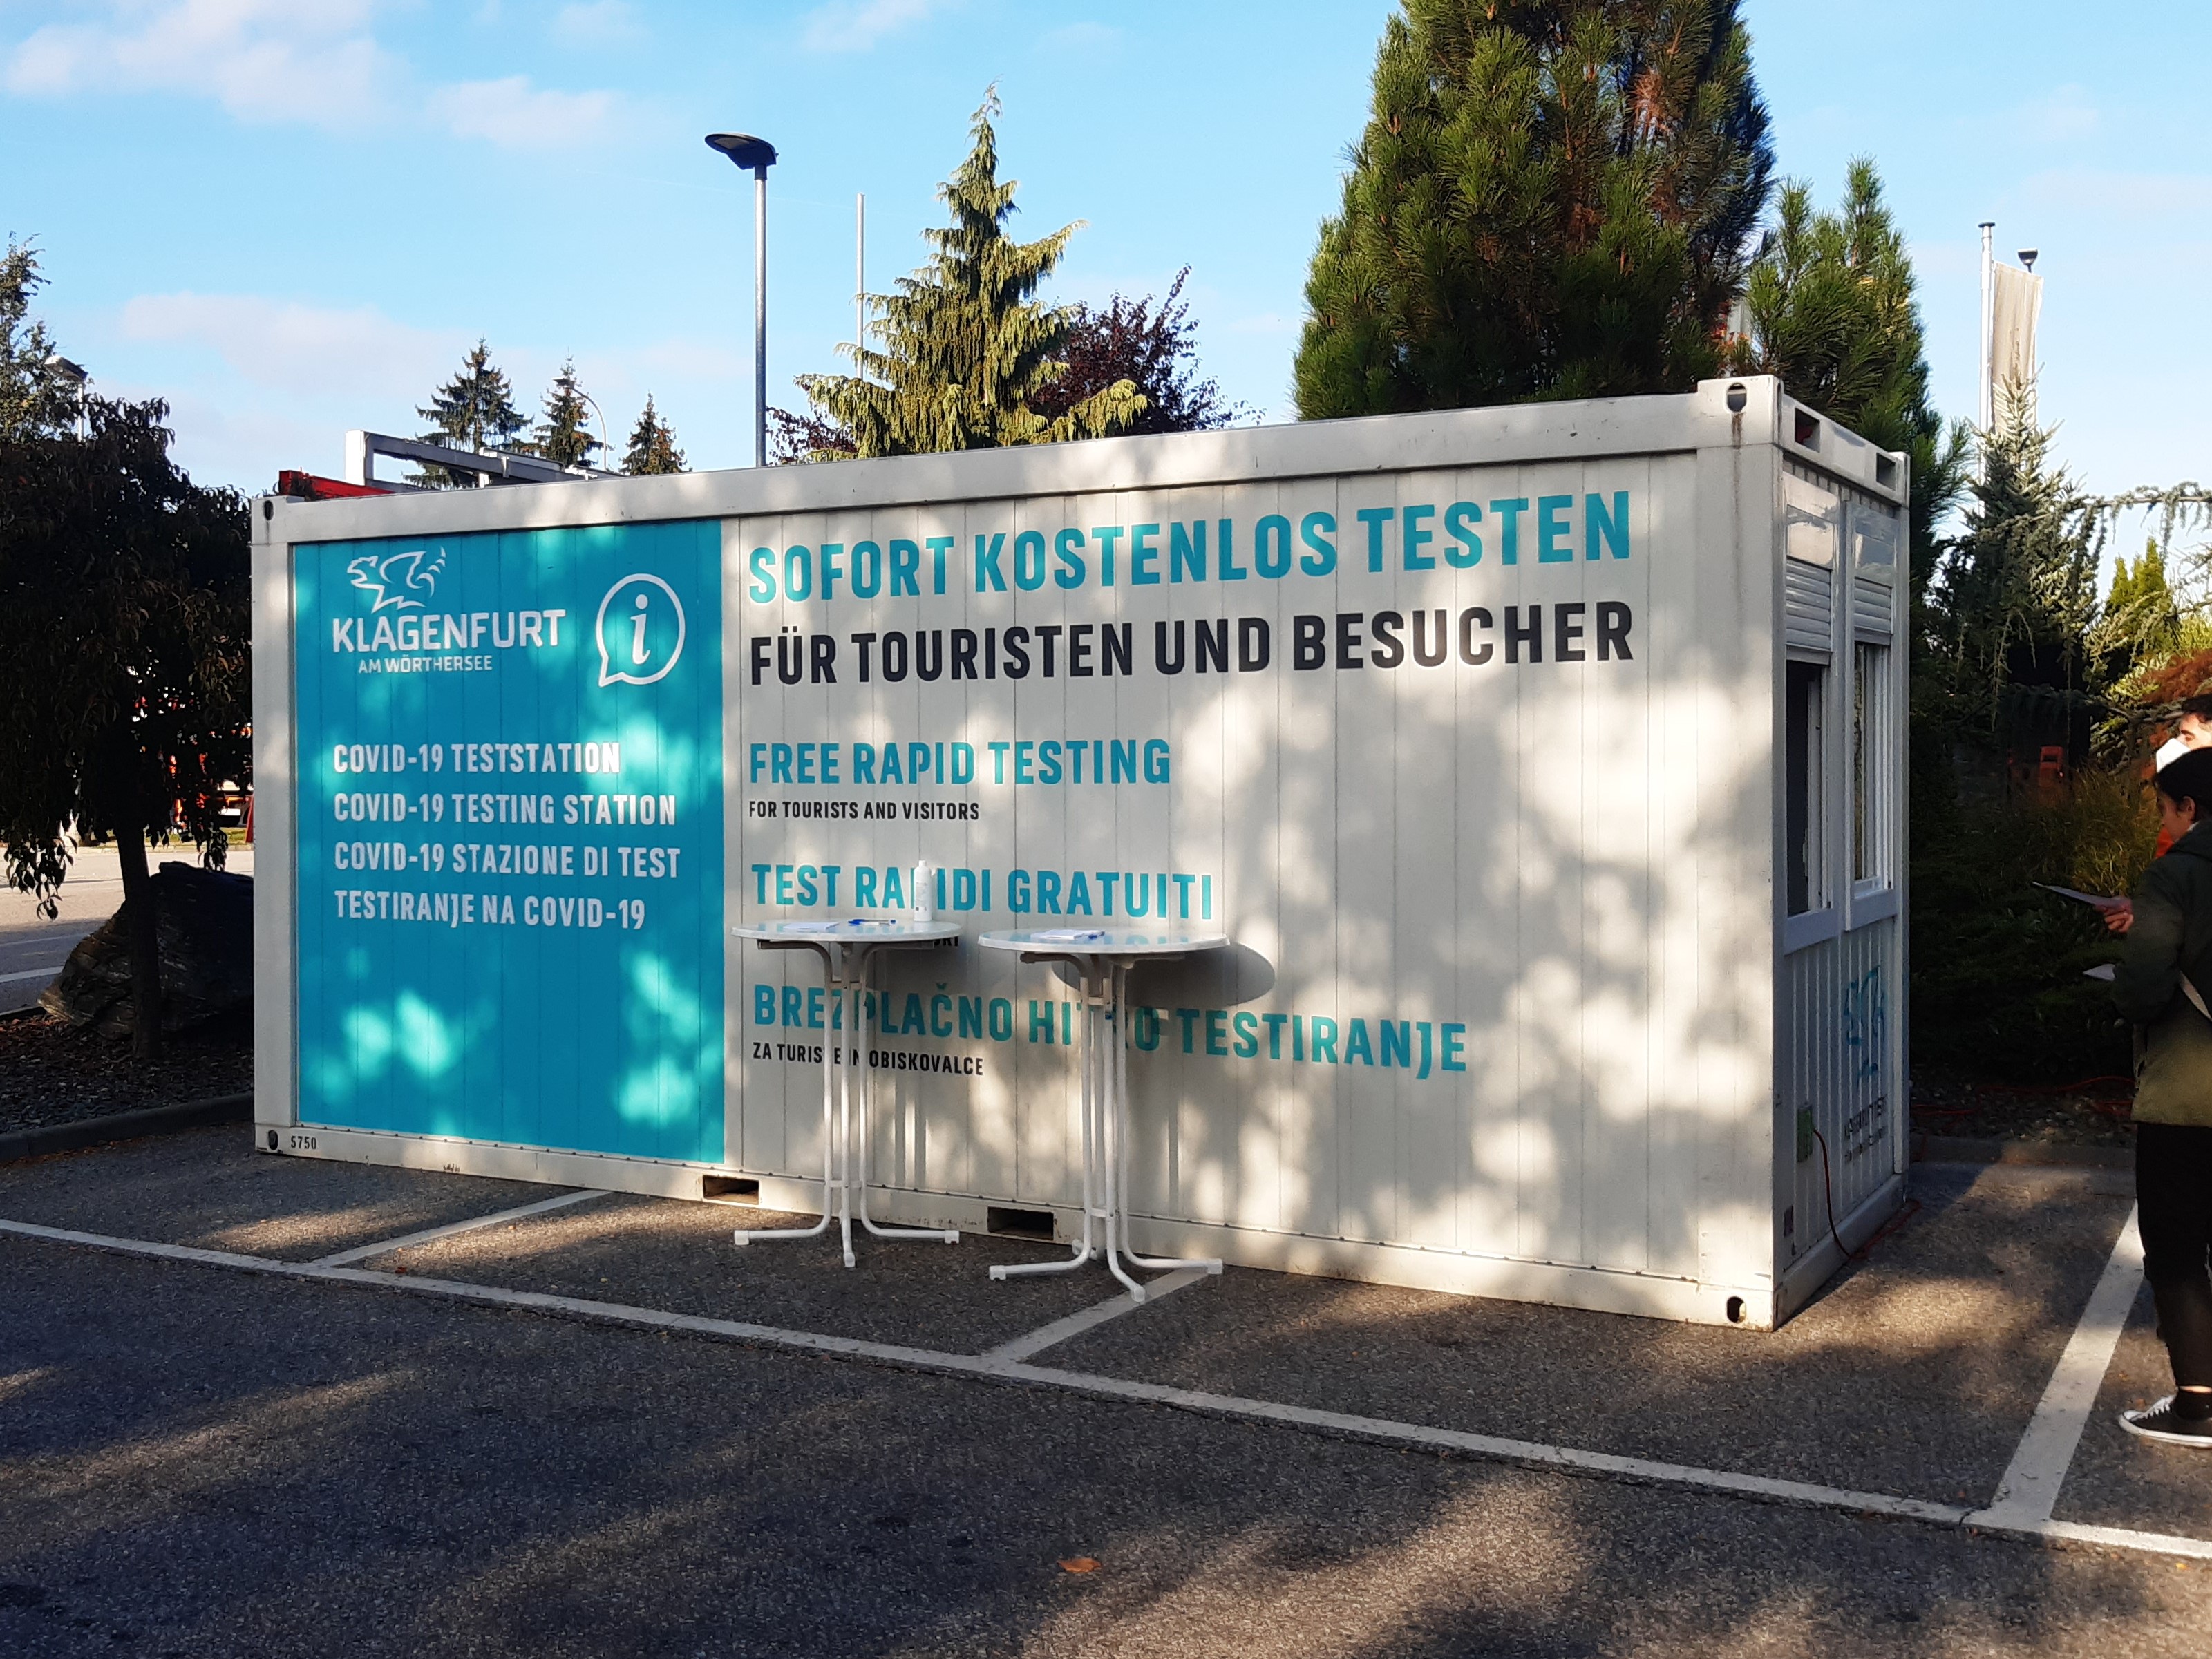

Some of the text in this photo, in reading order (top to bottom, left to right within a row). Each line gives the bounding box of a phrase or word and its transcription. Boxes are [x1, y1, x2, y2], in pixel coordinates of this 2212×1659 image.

[748, 491, 1629, 603] SOFORT KOSTENLOS TESTEN
[332, 609, 566, 653] KLAGENFURT
[751, 600, 1633, 685] FÜR TOURISTEN UND BESUCHER
[358, 654, 493, 674] AM WÖRTHERSEE
[334, 742, 621, 773] COVID-19 TESTSTATION
[750, 739, 1170, 784] FREE RAPID TESTING
[334, 793, 676, 825] COVID-19 TESTING STATION
[749, 800, 979, 820] FOR TOURISTS AND VISITORS
[334, 842, 680, 878] COVID-19 STAZIONE DI TEST
[334, 890, 645, 929] TESTIRANJE NA COVID-19
[751, 864, 841, 907] TEST
[856, 866, 990, 911] RAIDI
[1008, 869, 1211, 920] GRATUITI
[753, 1042, 772, 1059] ZA
[777, 1043, 841, 1065] TURISE
[869, 1050, 984, 1076] OBISKOVALCE
[1176, 1007, 1466, 1080] TESTIRANJE
[290, 1135, 317, 1150] 5750
